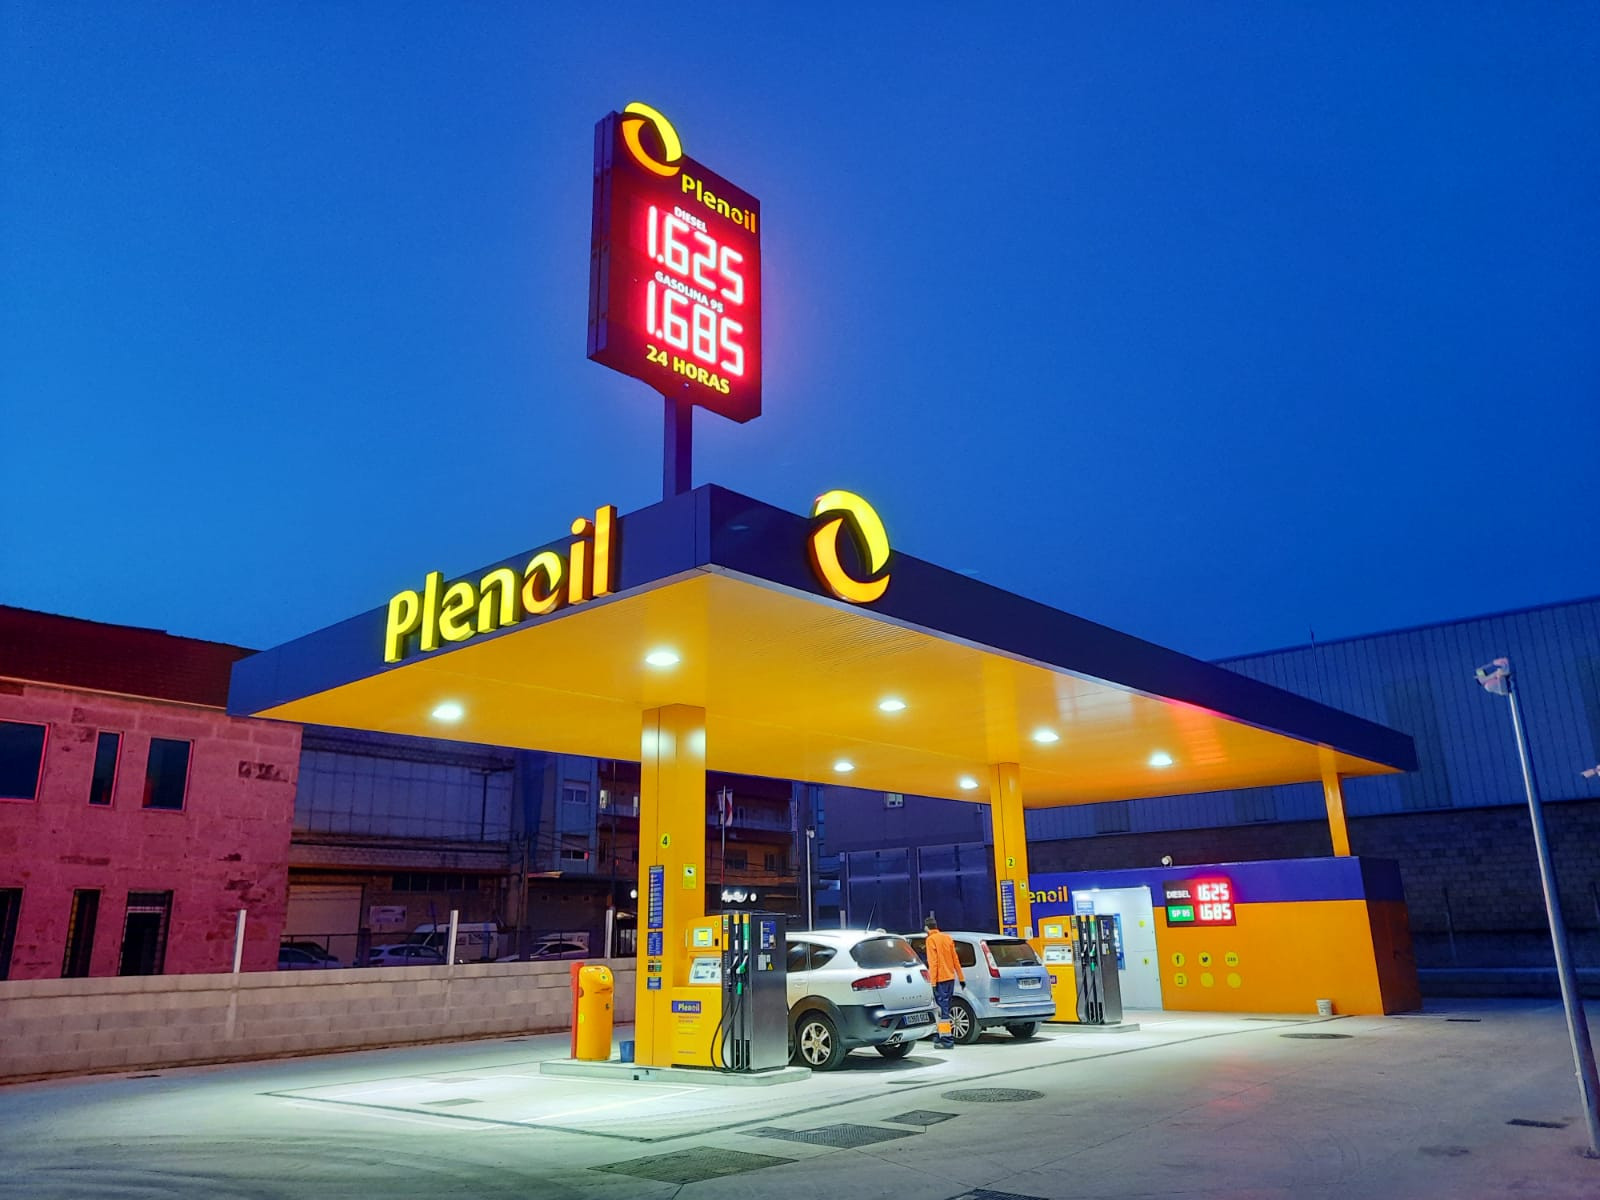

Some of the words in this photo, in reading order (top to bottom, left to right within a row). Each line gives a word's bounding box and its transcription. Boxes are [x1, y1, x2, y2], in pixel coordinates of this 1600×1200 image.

[674, 205, 707, 233] DIESEL
[681, 173, 756, 233] Plenoil
[647, 205, 744, 305] 1.625
[654, 270, 709, 307] GASOLINA
[709, 298, 724, 313] 95
[646, 279, 744, 377] 1.685
[646, 344, 668, 368] 24
[673, 356, 731, 394] HORAS
[384, 504, 617, 663] Plenoil
[1166, 890, 1191, 899] DIESEL
